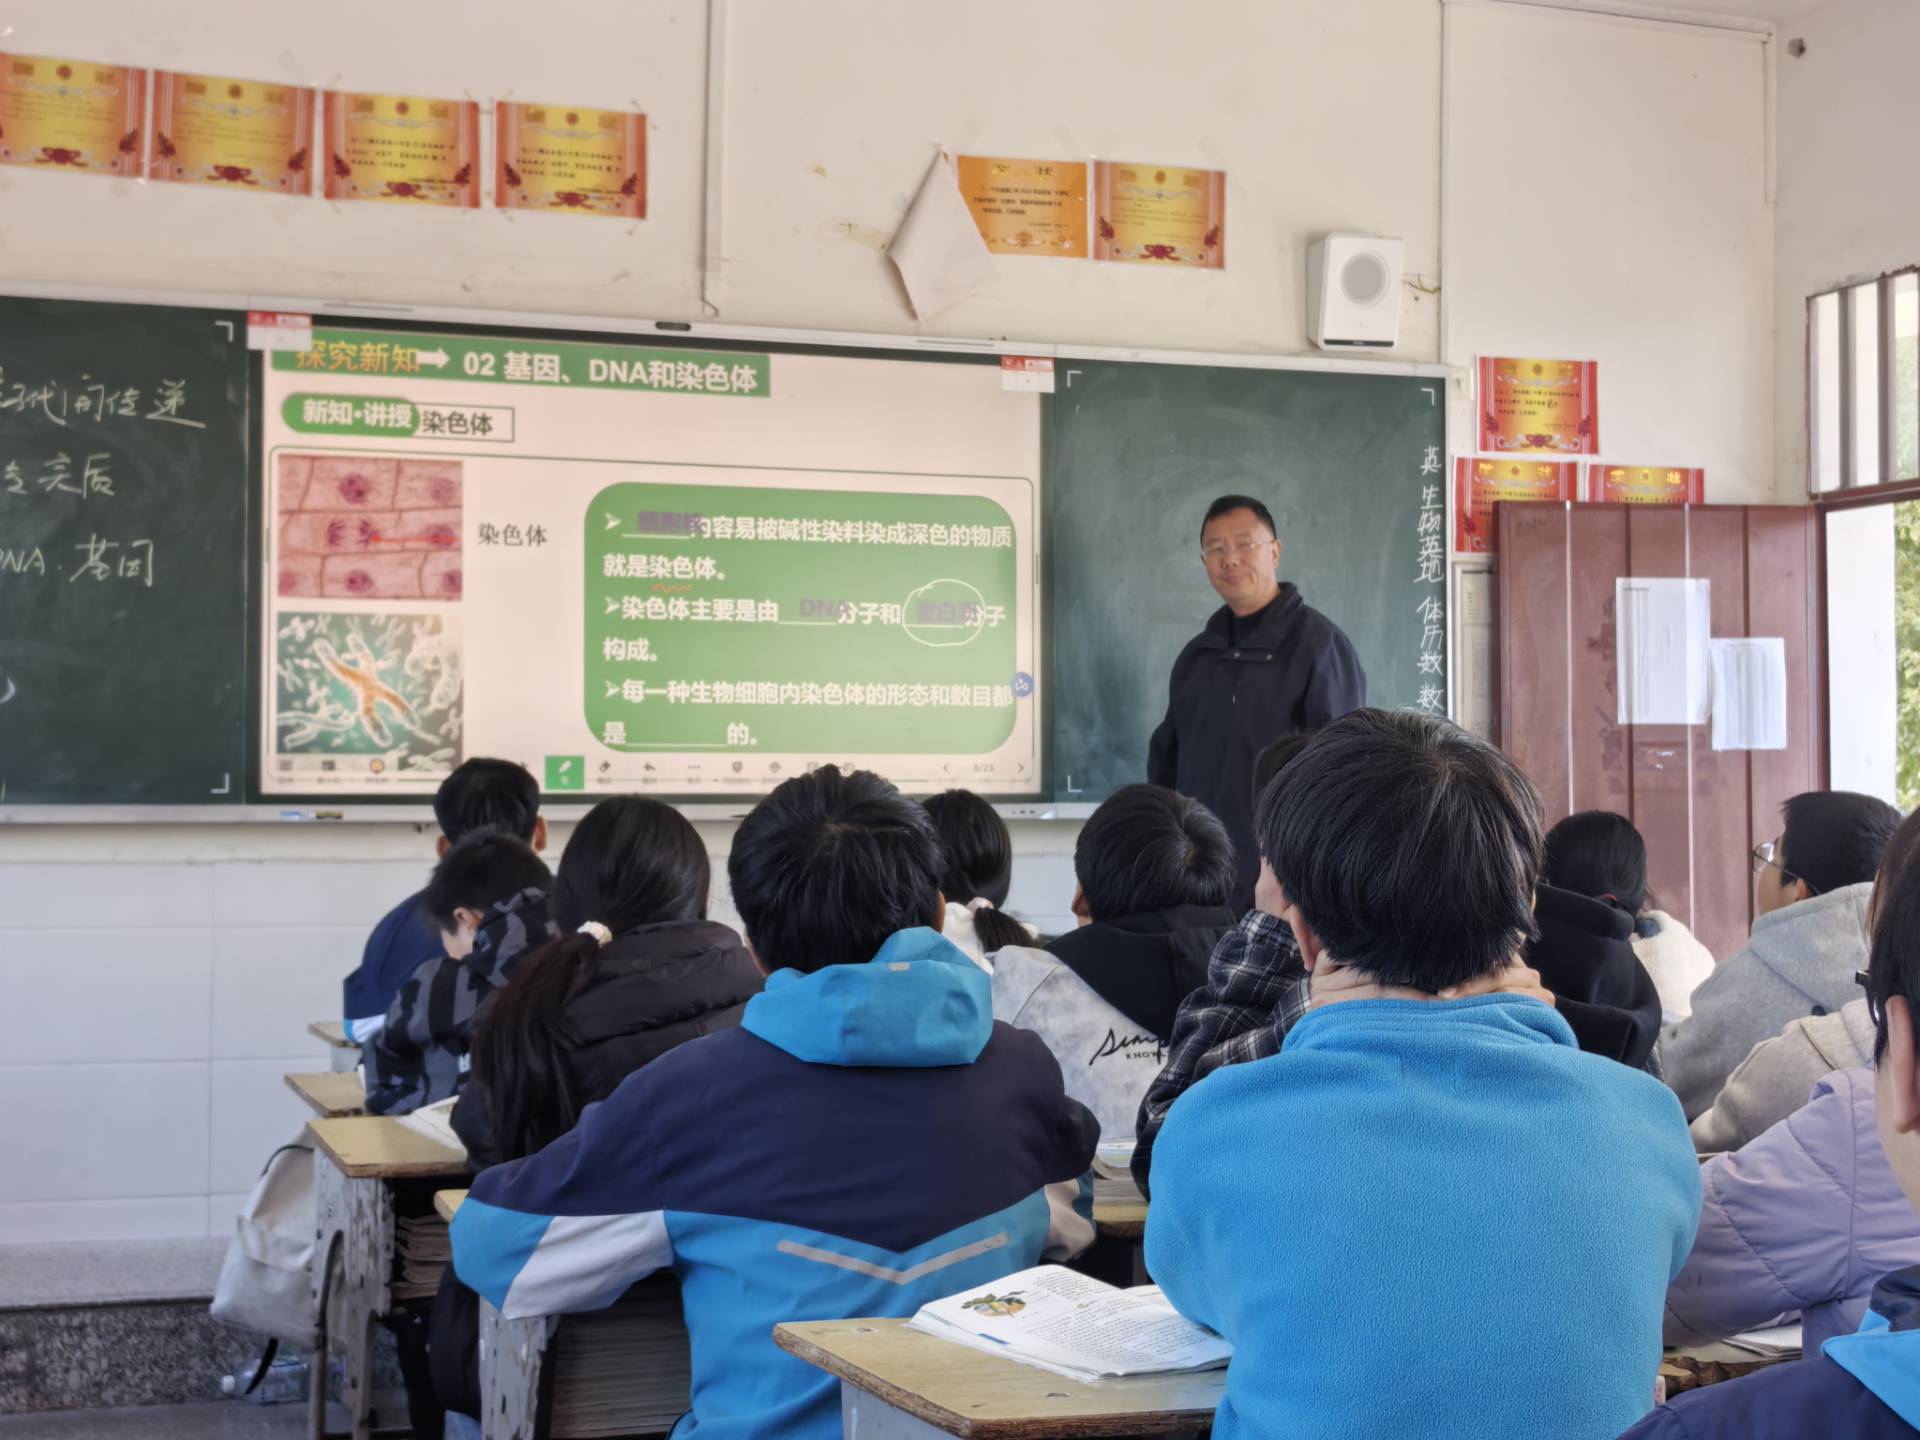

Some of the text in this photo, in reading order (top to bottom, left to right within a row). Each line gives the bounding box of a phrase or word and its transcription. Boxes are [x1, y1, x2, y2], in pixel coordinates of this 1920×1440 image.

[296, 340, 758, 393] 探究新知 02 基因、DNA和染色体
[422, 410, 493, 436] 染色体
[477, 522, 548, 547] 染色体
[603, 553, 726, 581] 就是染色体。
[622, 597, 778, 623] 染色体主要是由
[603, 638, 657, 662] 构成。
[622, 680, 1013, 708] 每一种生物细胞内染色体的形态和数目都
